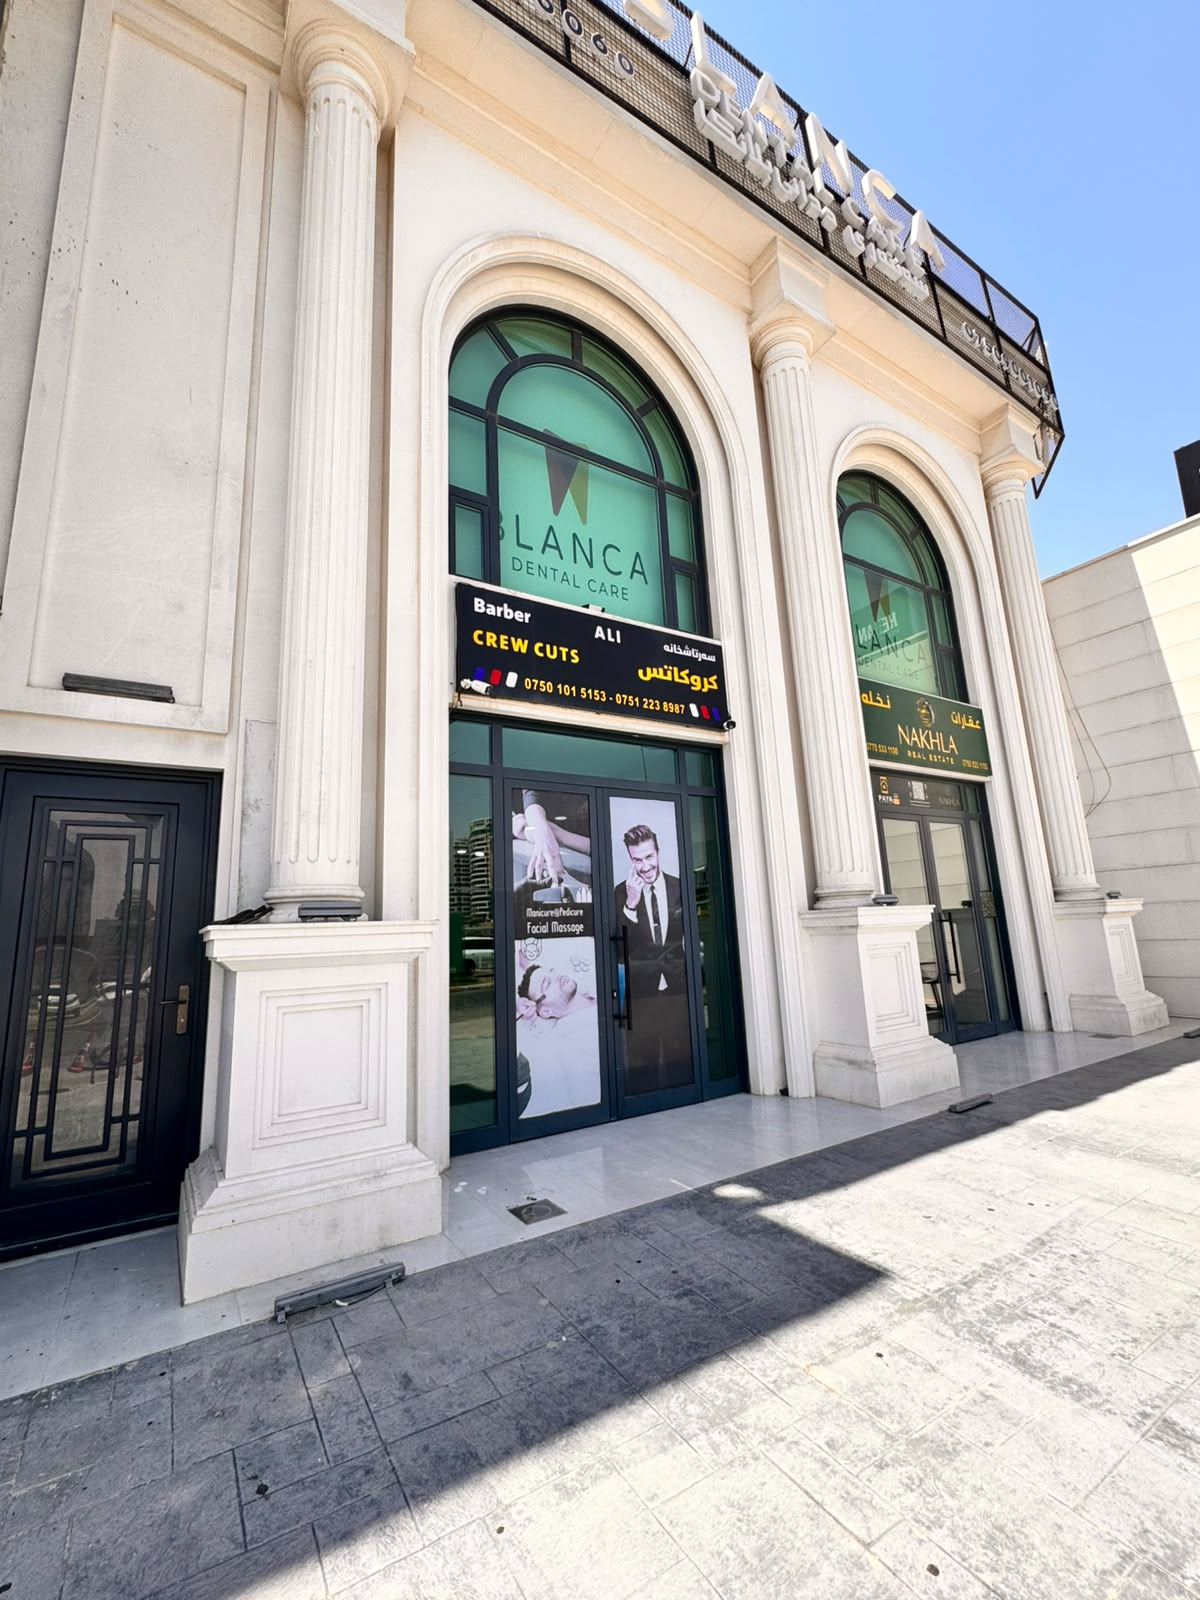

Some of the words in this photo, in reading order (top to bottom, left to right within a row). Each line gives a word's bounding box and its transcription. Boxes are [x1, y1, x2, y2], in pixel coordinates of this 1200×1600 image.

[690, 68, 834, 205] DENTAL
[841, 196, 926, 280] CARE
[511, 556, 581, 589] DENTAL
[587, 579, 629, 601] CARE
[473, 597, 532, 624] Barber
[472, 629, 529, 654] CREW
[533, 642, 580, 664] CUTS
[594, 625, 622, 644] ALI
[523, 677, 554, 694] 0750
[556, 682, 577, 697] 101
[580, 687, 607, 703] 5153
[615, 689, 640, 707] 0751
[642, 697, 661, 711] 223
[662, 699, 686, 715] 8987
[897, 723, 959, 755] NAKHLA
[907, 749, 926, 761] REAL
[929, 754, 955, 765] ESTATE
[527, 921, 549, 934] Facial
[551, 920, 584, 935] Massage
